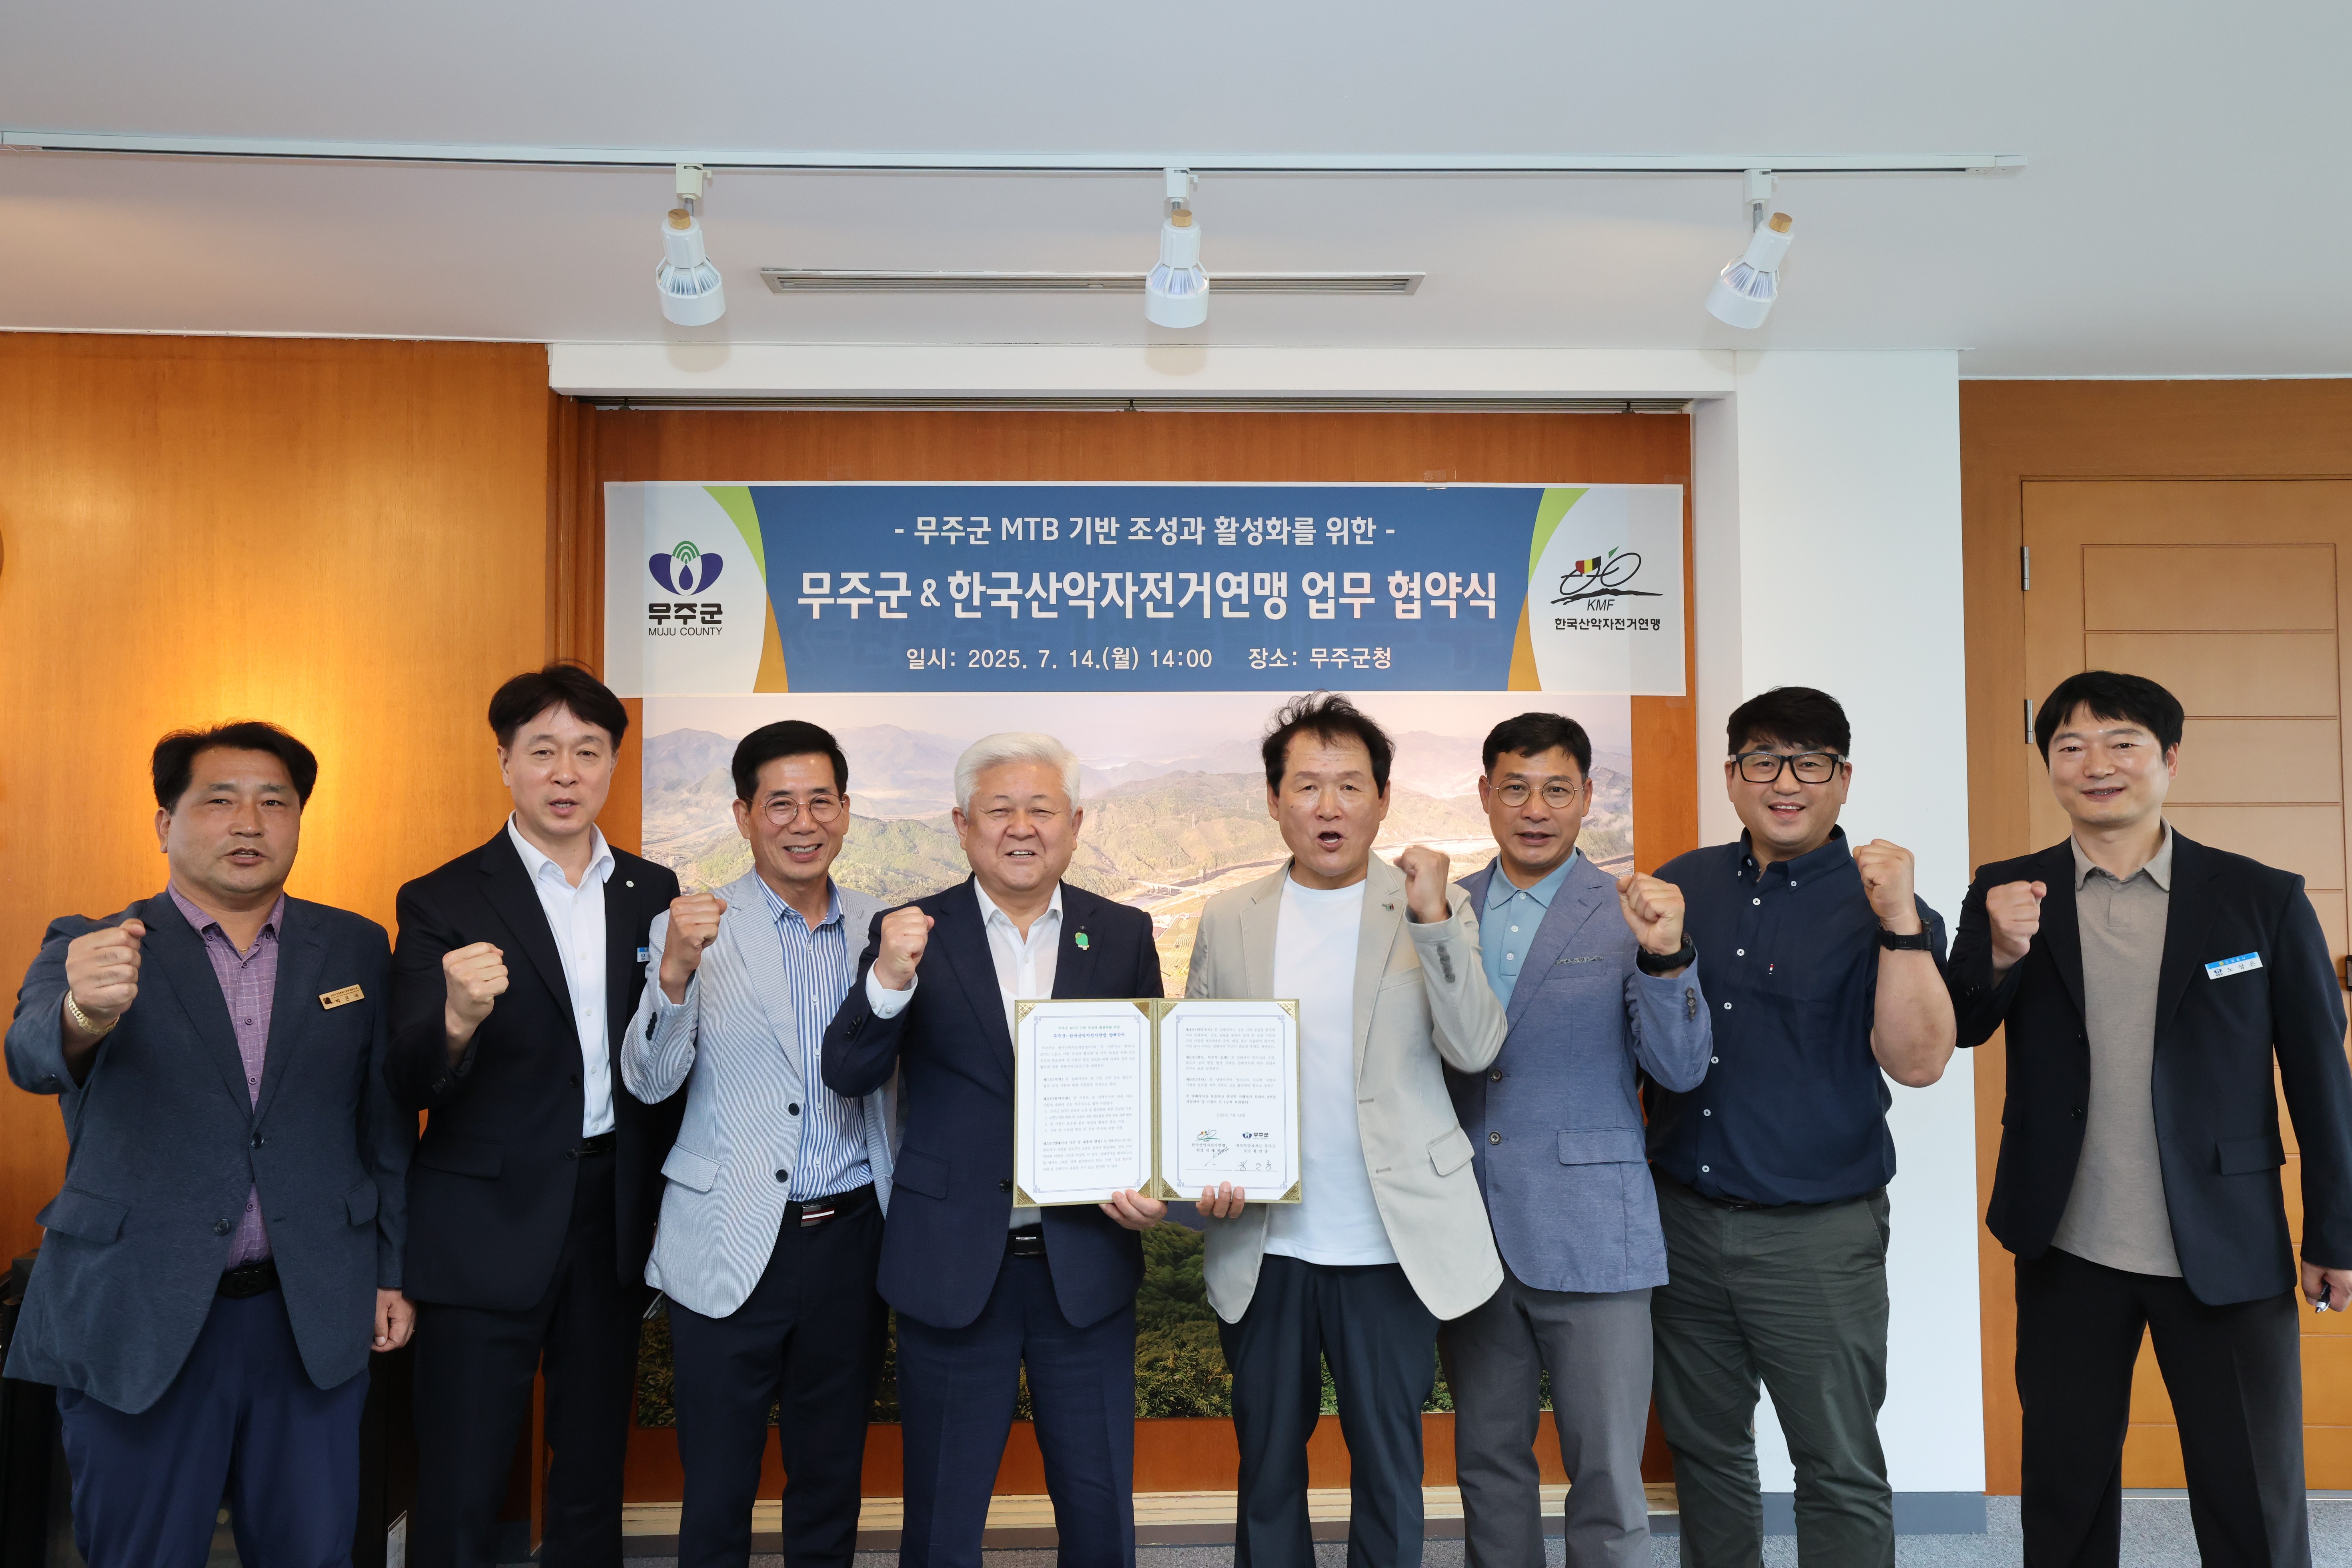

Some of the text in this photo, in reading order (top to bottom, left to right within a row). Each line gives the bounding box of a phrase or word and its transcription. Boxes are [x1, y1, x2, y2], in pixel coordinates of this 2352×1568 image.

[915, 517, 991, 544] 무주군
[1002, 518, 1058, 540] MTB
[1070, 517, 1119, 545] 기반
[1128, 517, 1205, 545] 조성과
[1214, 516, 1316, 545] 활성화를
[1326, 517, 1376, 545] 위한
[798, 571, 1495, 619] 무주군 & 한국산악자전거연맹 업무 협약식
[1587, 599, 1615, 611] KMF
[649, 603, 722, 625] 무주군
[1555, 618, 1660, 631] 한국산악자전거연맹
[680, 627, 722, 635] COUNTY
[907, 647, 1212, 670] 일시: 2025. 7. 14.(월) 14:00
[1249, 647, 1390, 669] 장소: 무주군청
